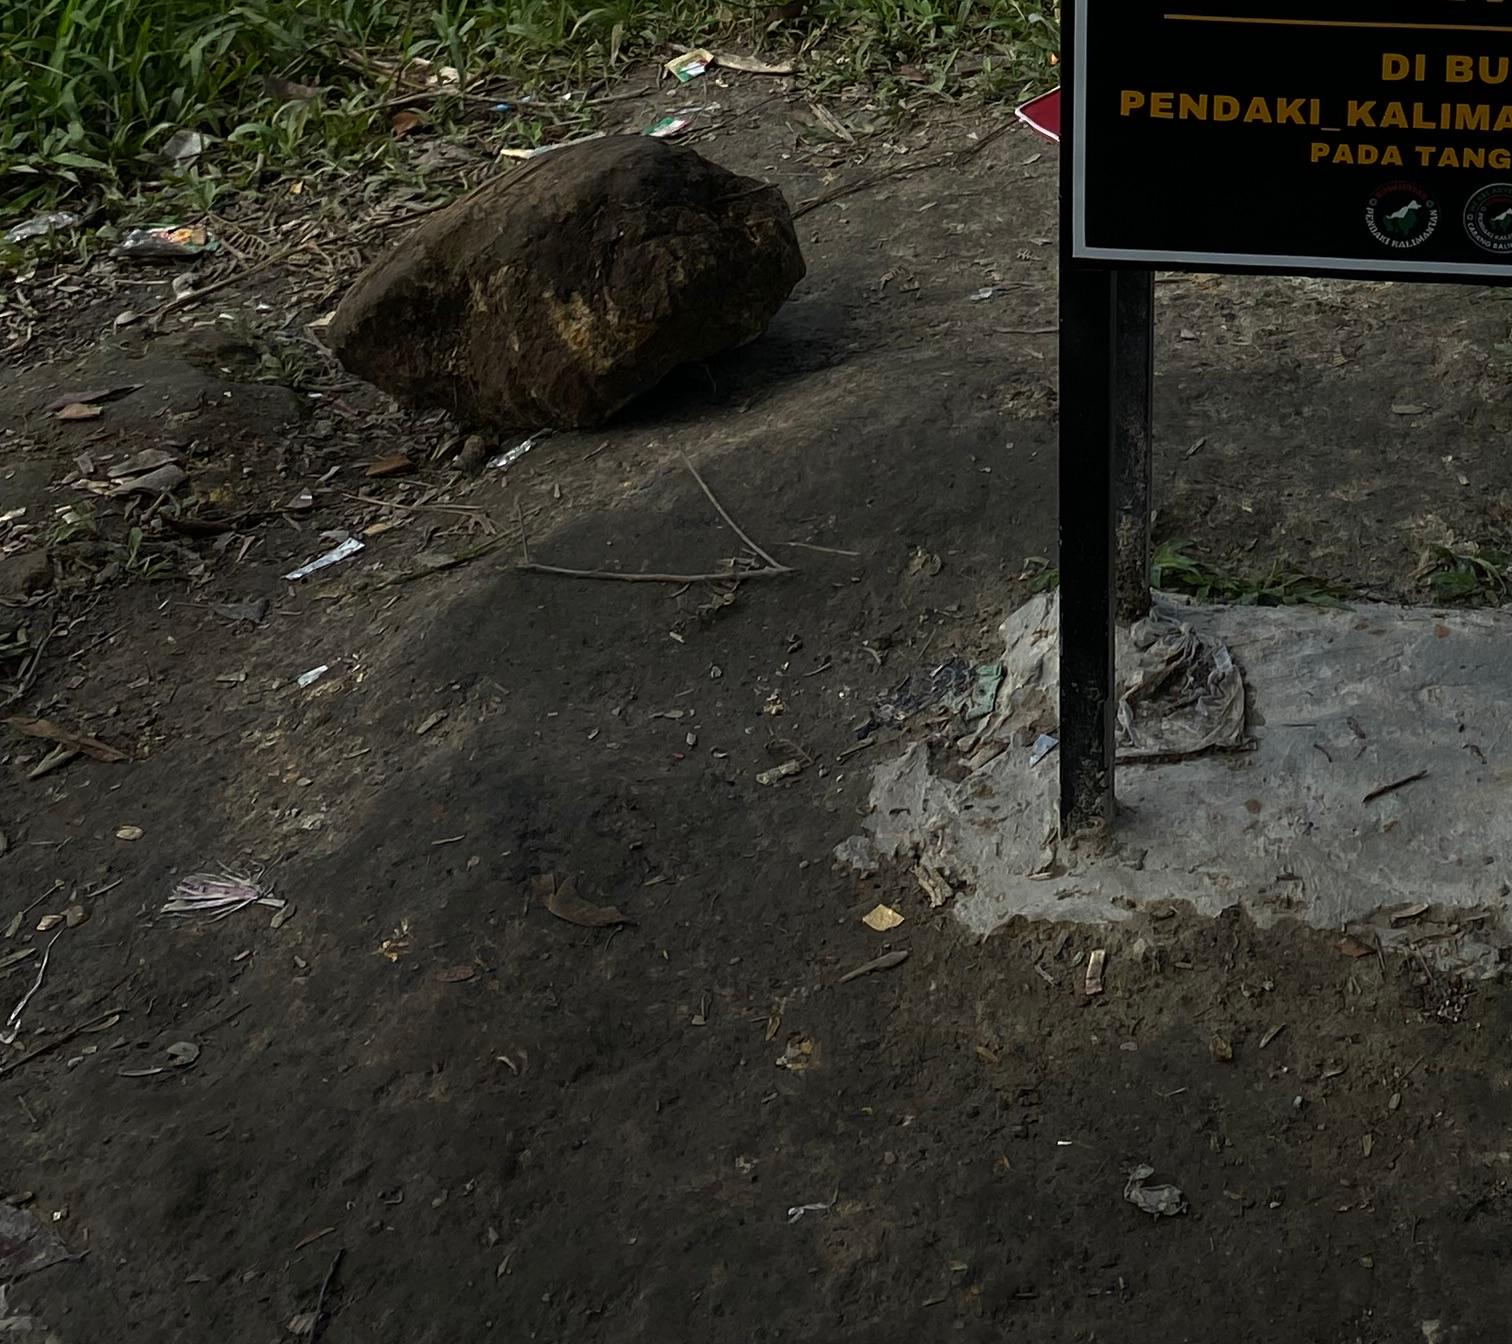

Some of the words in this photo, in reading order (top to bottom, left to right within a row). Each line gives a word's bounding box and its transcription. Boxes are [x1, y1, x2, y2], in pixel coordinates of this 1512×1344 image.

[1382, 53, 1425, 81] DI
[1311, 143, 1402, 165] PADA
[1365, 206, 1391, 246] PENDAKI
[1391, 208, 1438, 249] KALIMANTAN
